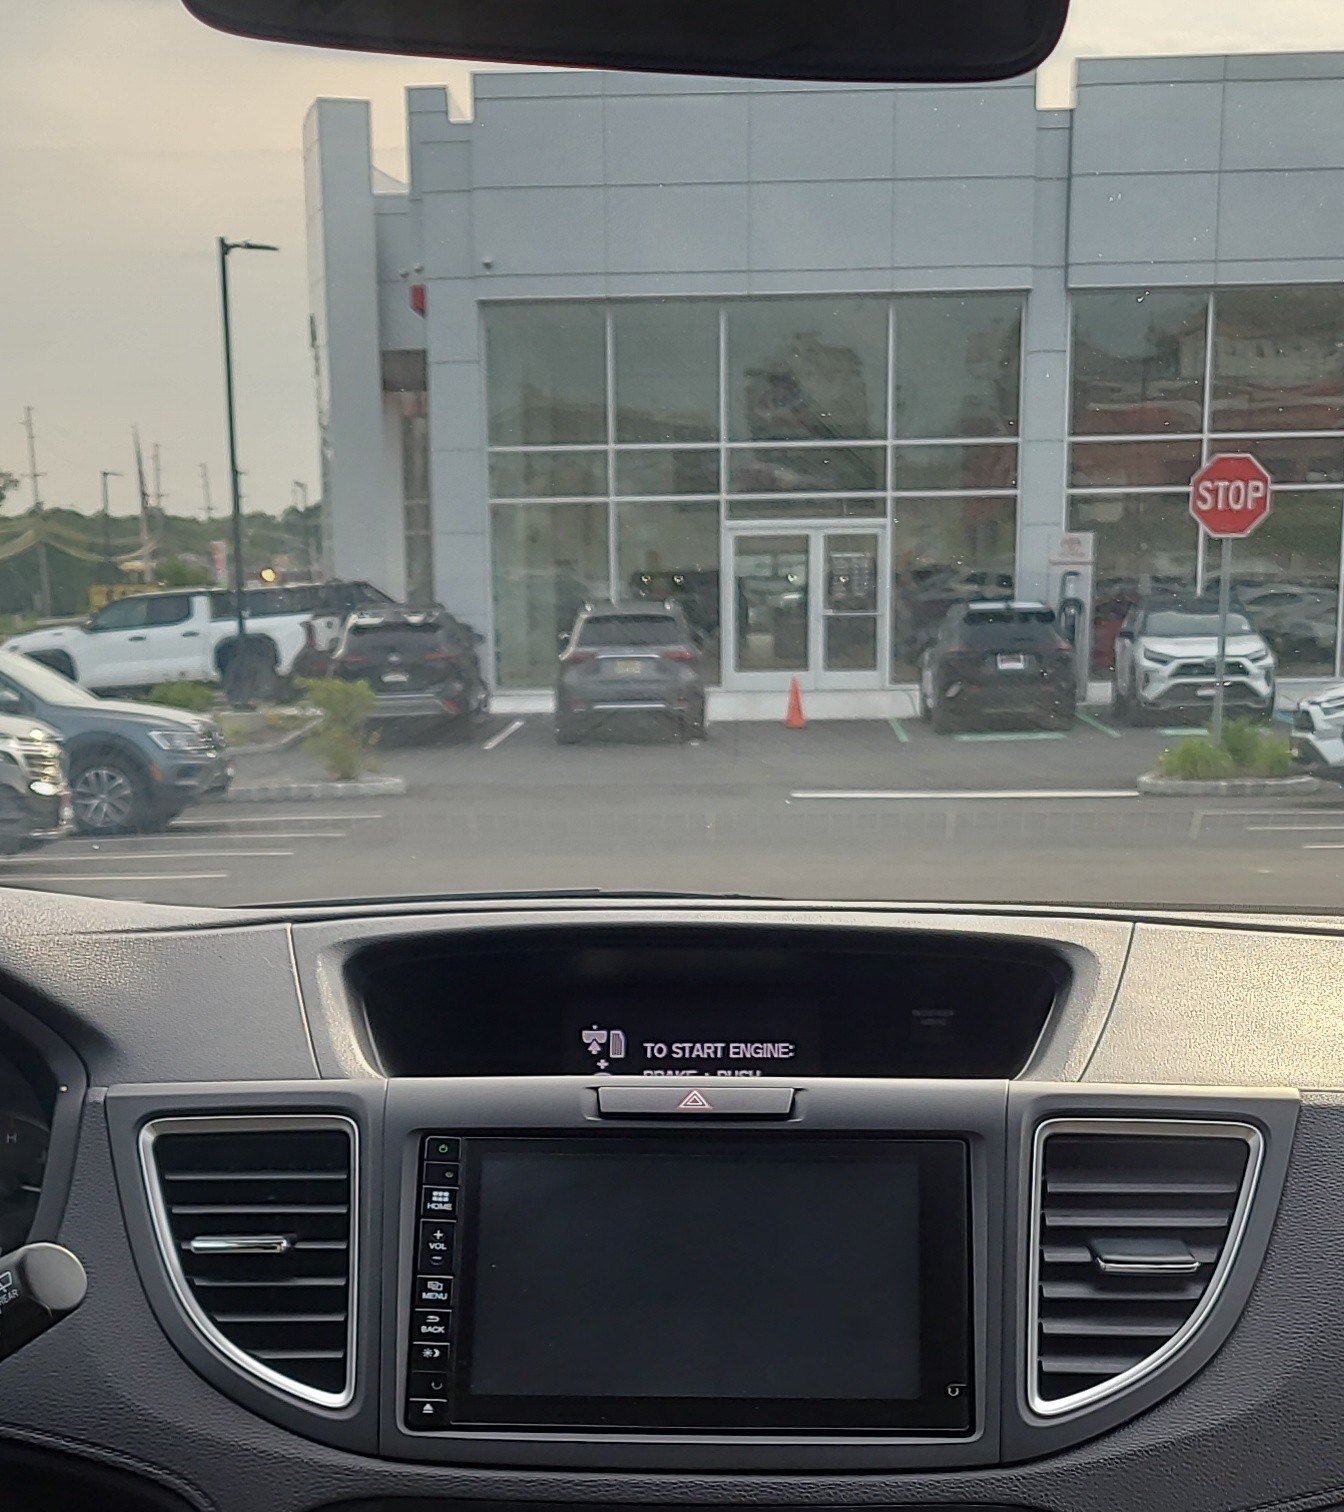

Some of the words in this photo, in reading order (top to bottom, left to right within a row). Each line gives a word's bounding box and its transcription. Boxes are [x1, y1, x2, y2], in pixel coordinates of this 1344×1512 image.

[1197, 479, 1265, 511] STOP
[642, 1042, 667, 1058] TO
[671, 1042, 725, 1058] START
[729, 1042, 796, 1059] ENGINE:
[427, 1202, 453, 1212] HOME
[429, 1242, 447, 1251] VOL
[422, 1292, 448, 1300] MENU
[421, 1325, 445, 1334] BACK
